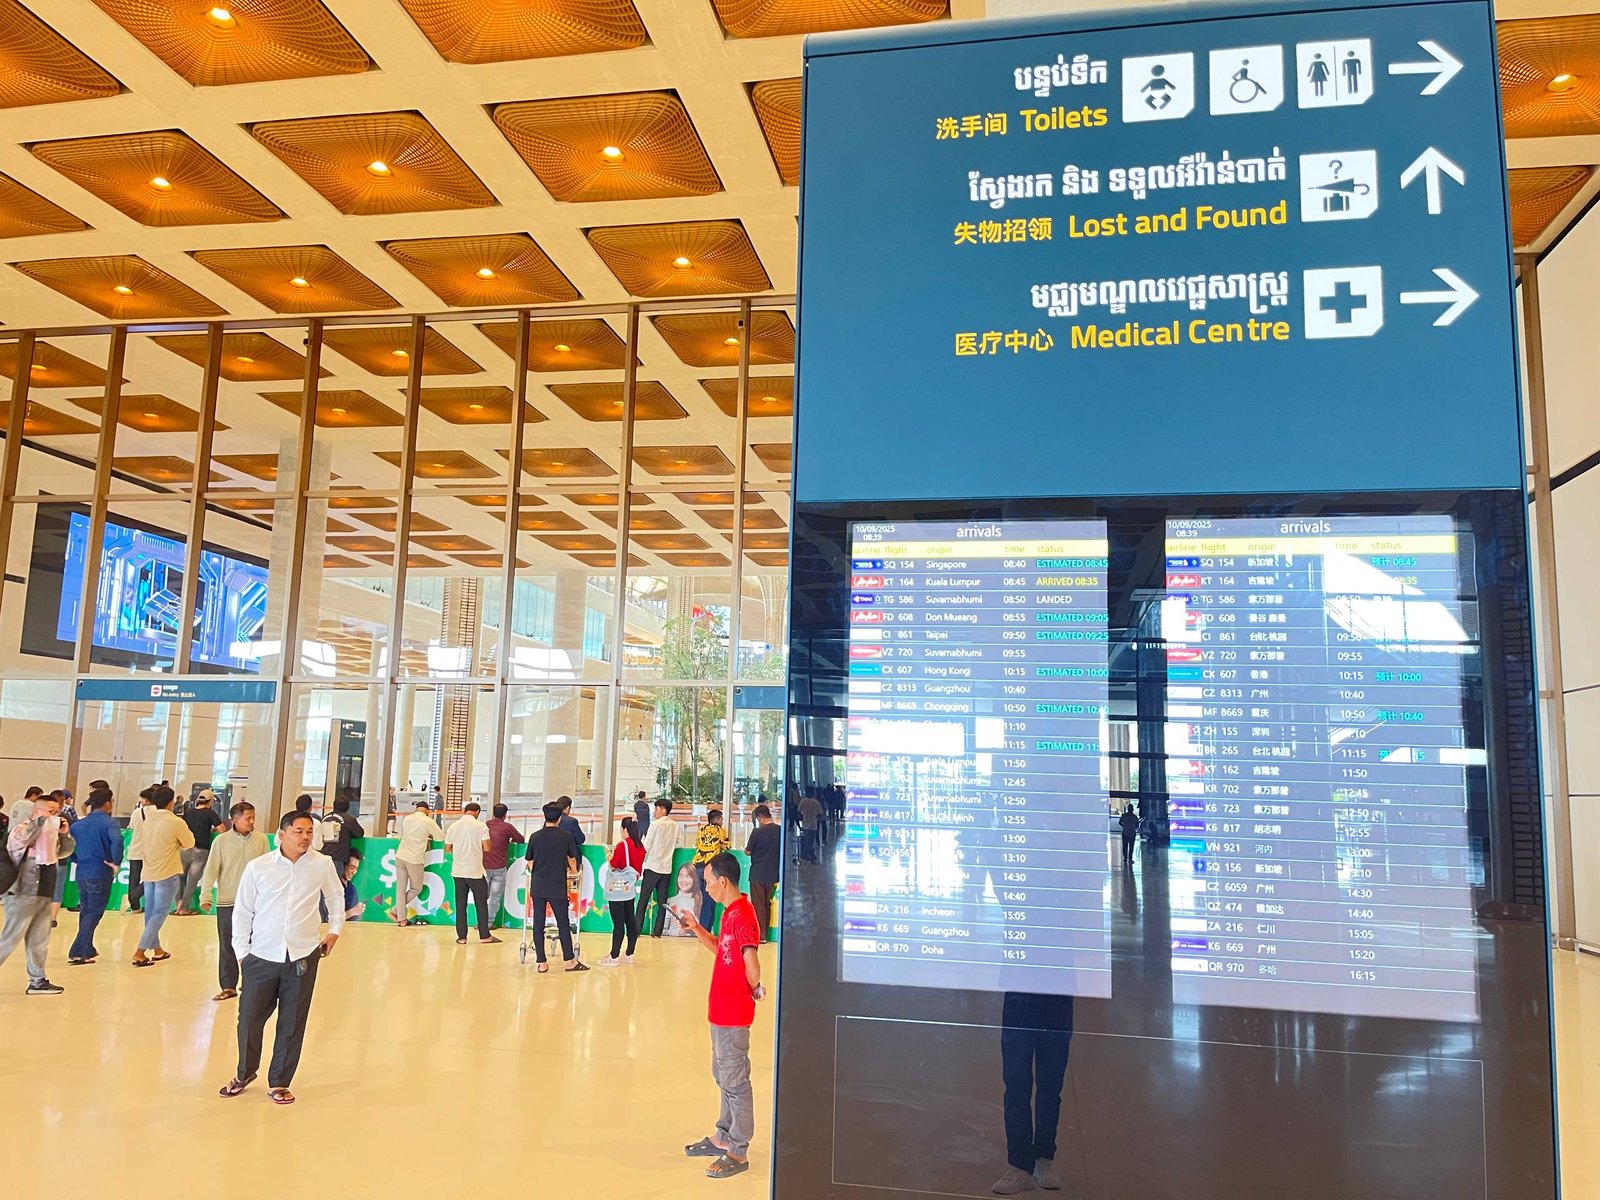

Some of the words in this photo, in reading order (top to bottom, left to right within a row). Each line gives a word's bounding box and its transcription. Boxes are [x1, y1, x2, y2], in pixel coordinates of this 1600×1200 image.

[1014, 54, 1107, 97] បន្ទប់ទឹក
[936, 112, 1007, 140] 洗手间
[1020, 106, 1108, 132] Toilets
[969, 171, 1052, 209] ស្វែងរក
[1062, 165, 1099, 195] និង
[1109, 147, 1286, 200] ទទួលអីវ៉ាន់បាត់
[954, 218, 1052, 245] 失物招领
[1069, 214, 1128, 239] Lost
[1135, 208, 1187, 234] and
[1197, 200, 1287, 229] Found
[956, 329, 1054, 356] 医疗中心
[1071, 321, 1180, 348] Medical
[1189, 319, 1289, 344] Centre
[856, 525, 896, 534] 10/09/2025
[956, 525, 1002, 538] arrivals
[1167, 521, 1212, 529] 10/09/2025
[1280, 520, 1331, 533] arrivals
[1037, 545, 1064, 553] status
[1167, 543, 1197, 551] airline
[1201, 543, 1226, 553] flight
[1248, 543, 1277, 553] origin
[1371, 541, 1402, 550] status
[884, 560, 896, 569] SQ
[926, 560, 967, 570] Singapore
[1003, 560, 1026, 568] 08:40
[1036, 559, 1083, 568] ESTIMATED
[1085, 559, 1109, 568] 08:45
[1201, 558, 1214, 568] SQ
[1218, 558, 1234, 566] 154
[1393, 558, 1416, 566] 08:45
[900, 578, 914, 586] 164
[926, 578, 948, 586] Kuala
[950, 578, 981, 588] Lumpur
[1003, 578, 1026, 586] 08:45
[1036, 577, 1073, 586] ARRIVED
[1075, 577, 1098, 586] 08:35
[1201, 577, 1212, 585] KT
[1219, 577, 1235, 585] 164
[925, 595, 982, 604] Suvarnabhumi
[1036, 596, 1072, 604] LANDED
[1201, 595, 1213, 603] TG
[1219, 595, 1235, 603] 586
[898, 613, 913, 621] 608
[925, 613, 942, 621] Don
[944, 613, 977, 623] Mueang
[1036, 613, 1084, 622] ESTIMATED
[1085, 613, 1109, 622] 09:05
[1219, 614, 1236, 622] 608
[925, 631, 948, 640] Taipei
[1003, 631, 1026, 639] 09:50
[1036, 631, 1084, 640] ESTIMATED
[1086, 632, 1109, 640] 09:25
[1219, 632, 1235, 641] 861
[898, 648, 913, 656] 720
[925, 648, 982, 657] Suvarnabhumi
[1003, 649, 1026, 657] 09:55
[1202, 651, 1215, 660] VZ
[1220, 651, 1236, 660] 720
[1337, 652, 1363, 661] 09:55
[897, 666, 912, 674] 607
[925, 666, 946, 676] Hong
[949, 667, 970, 676] Kong
[1003, 668, 1026, 676] 10:15
[1036, 668, 1084, 676] ESTIMATED
[1087, 668, 1109, 676] 10:00
[1202, 670, 1215, 678] CX
[1220, 670, 1237, 678] 607
[1250, 670, 1269, 679] 香港
[1339, 671, 1364, 680] 10:15
[1398, 672, 1422, 681] 10:00
[897, 684, 917, 692] 8313
[924, 684, 970, 694] Guangzhou
[1203, 689, 1216, 697] CZ
[1220, 689, 1242, 698] 8313
[1251, 689, 1269, 698] 广州
[1340, 691, 1364, 699] 10:40
[924, 702, 968, 712] Chongqing
[1003, 704, 1026, 712] 10:50
[1036, 704, 1084, 713] ESTIMATED
[1203, 708, 1217, 716] MF
[1221, 708, 1243, 717] 8669
[1340, 710, 1365, 719] 10:50
[1400, 712, 1424, 721] 10:40
[1222, 727, 1238, 736] 155
[1252, 727, 1270, 737] 深圳
[1036, 741, 1084, 751] ESTIMATED
[1222, 746, 1239, 755] 265
[1342, 749, 1366, 758] 11:15
[1003, 760, 1026, 768] 11:50
[1222, 765, 1239, 774] 162
[1253, 766, 1280, 776] 吉隆坡
[1342, 769, 1367, 777] 11:50
[1003, 778, 1026, 786] 12:45
[1205, 785, 1217, 793] KR
[1223, 785, 1239, 794] 702
[1003, 797, 1026, 805] 12:50
[1206, 804, 1217, 812] K6
[1223, 804, 1240, 813] 723
[1003, 816, 1026, 824] 12:55
[1206, 824, 1218, 832] K6
[1223, 824, 1240, 833] 817
[1003, 834, 1026, 843] 13:00
[1206, 843, 1220, 851] VN
[1224, 843, 1240, 852] 921
[1255, 844, 1273, 854] 河内
[1003, 854, 1026, 863] 13:10
[1207, 863, 1220, 872] SQ
[1225, 863, 1242, 872] 156
[1003, 872, 1026, 882] 14:30
[1207, 882, 1220, 891] CZ
[1225, 882, 1247, 892] 6059
[1256, 884, 1274, 894] 广州
[1347, 889, 1372, 898] 14:30
[1003, 892, 1026, 901] 14:40
[893, 905, 909, 914] 216
[922, 907, 955, 916] Incheon
[1003, 911, 1026, 920] 15:05
[1225, 902, 1243, 912] 474
[1347, 909, 1373, 919] 14:40
[893, 925, 909, 933] 669
[921, 926, 969, 938] Guangzhou
[1003, 930, 1026, 940] 15:20
[1208, 922, 1221, 931] ZA
[1226, 922, 1243, 932] 216
[1257, 924, 1275, 934] 仁川
[1348, 929, 1374, 939] 15:05
[877, 943, 890, 952] QR
[893, 944, 909, 952] 970
[921, 945, 944, 955] Doha
[1003, 950, 1026, 959] 16:15
[1208, 942, 1220, 951] K6
[1226, 942, 1244, 952] 669
[1257, 944, 1276, 954] 广州
[1349, 950, 1375, 960] 15:20
[1208, 962, 1223, 972] QR
[1227, 962, 1244, 973] 970
[1258, 964, 1277, 974] 多哈
[1350, 970, 1376, 980] 16:15
